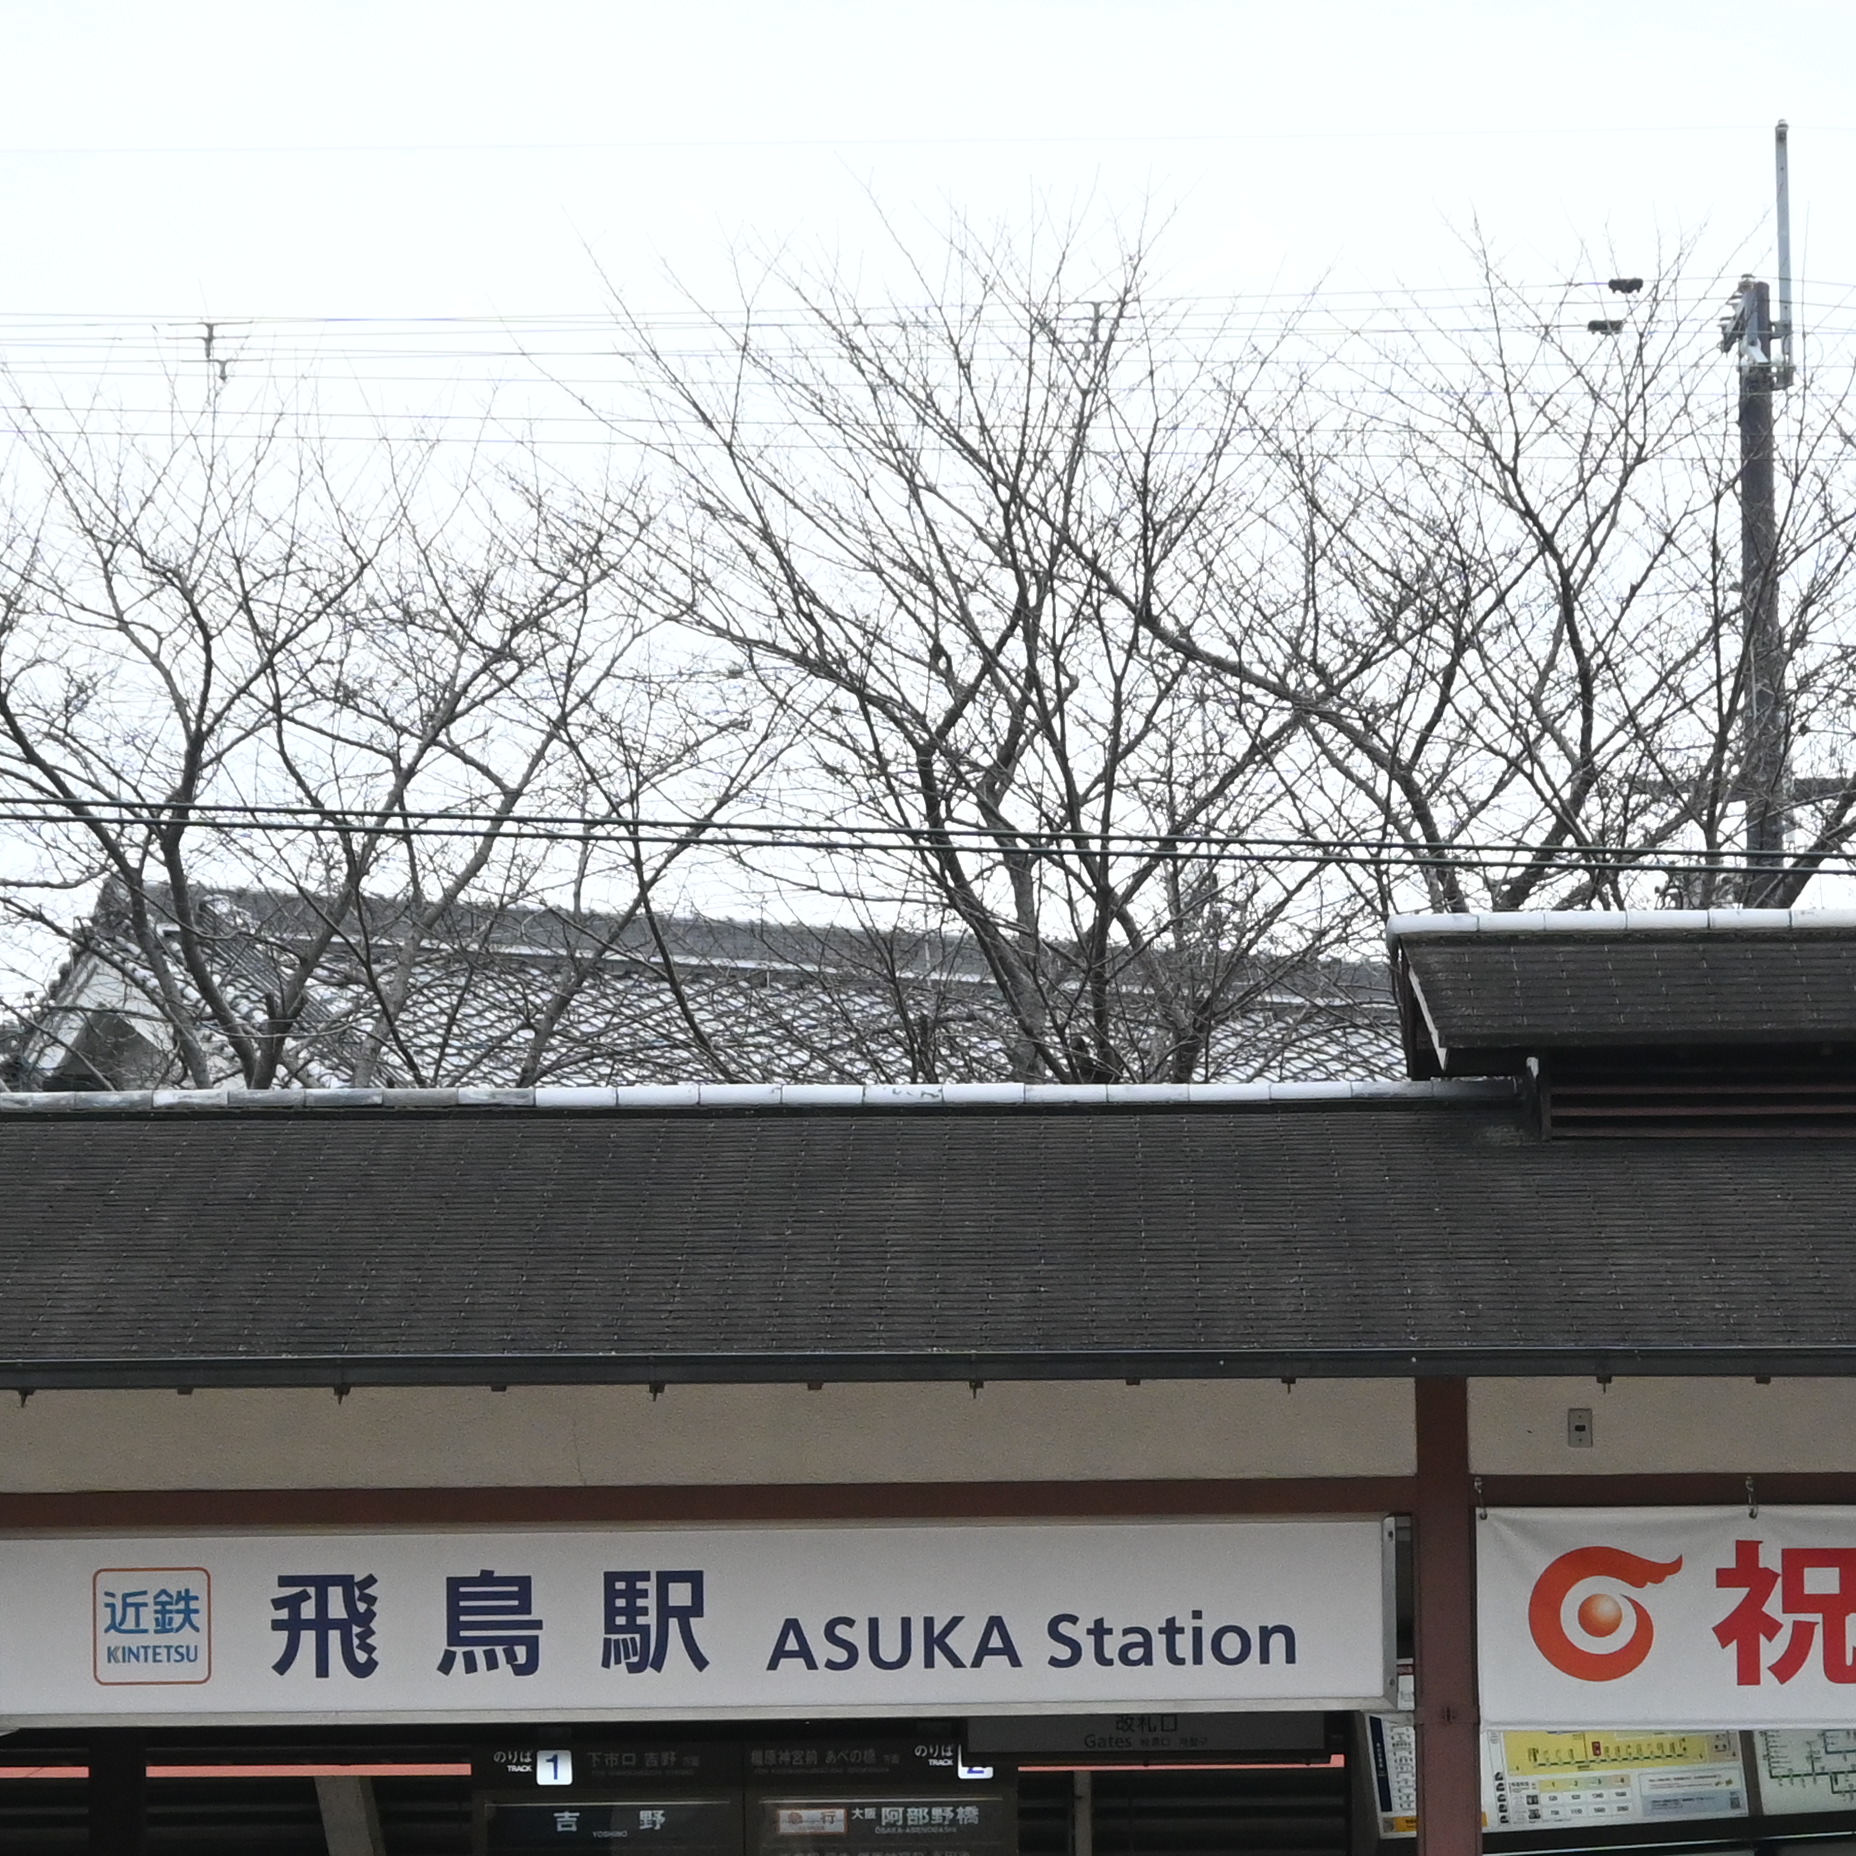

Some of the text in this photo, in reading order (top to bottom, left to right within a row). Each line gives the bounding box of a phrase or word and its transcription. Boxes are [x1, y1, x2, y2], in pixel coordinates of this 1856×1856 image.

[104, 1588, 201, 1637] 近鉄
[270, 1568, 711, 1680] 飛鳥駅
[766, 1609, 1298, 1672] ASUKA Station
[106, 1645, 200, 1665] KINTETSU
[1115, 1714, 1178, 1733] 改札口
[914, 1744, 954, 1757] のりば
[1084, 1734, 1133, 1749] Gates
[493, 1750, 533, 1763] のりば
[587, 1751, 637, 1768] 下市口
[927, 1758, 954, 1767] TRACK
[506, 1764, 533, 1773] TRACK
[545, 1754, 559, 1780] 1
[553, 1809, 666, 1833] 吉野
